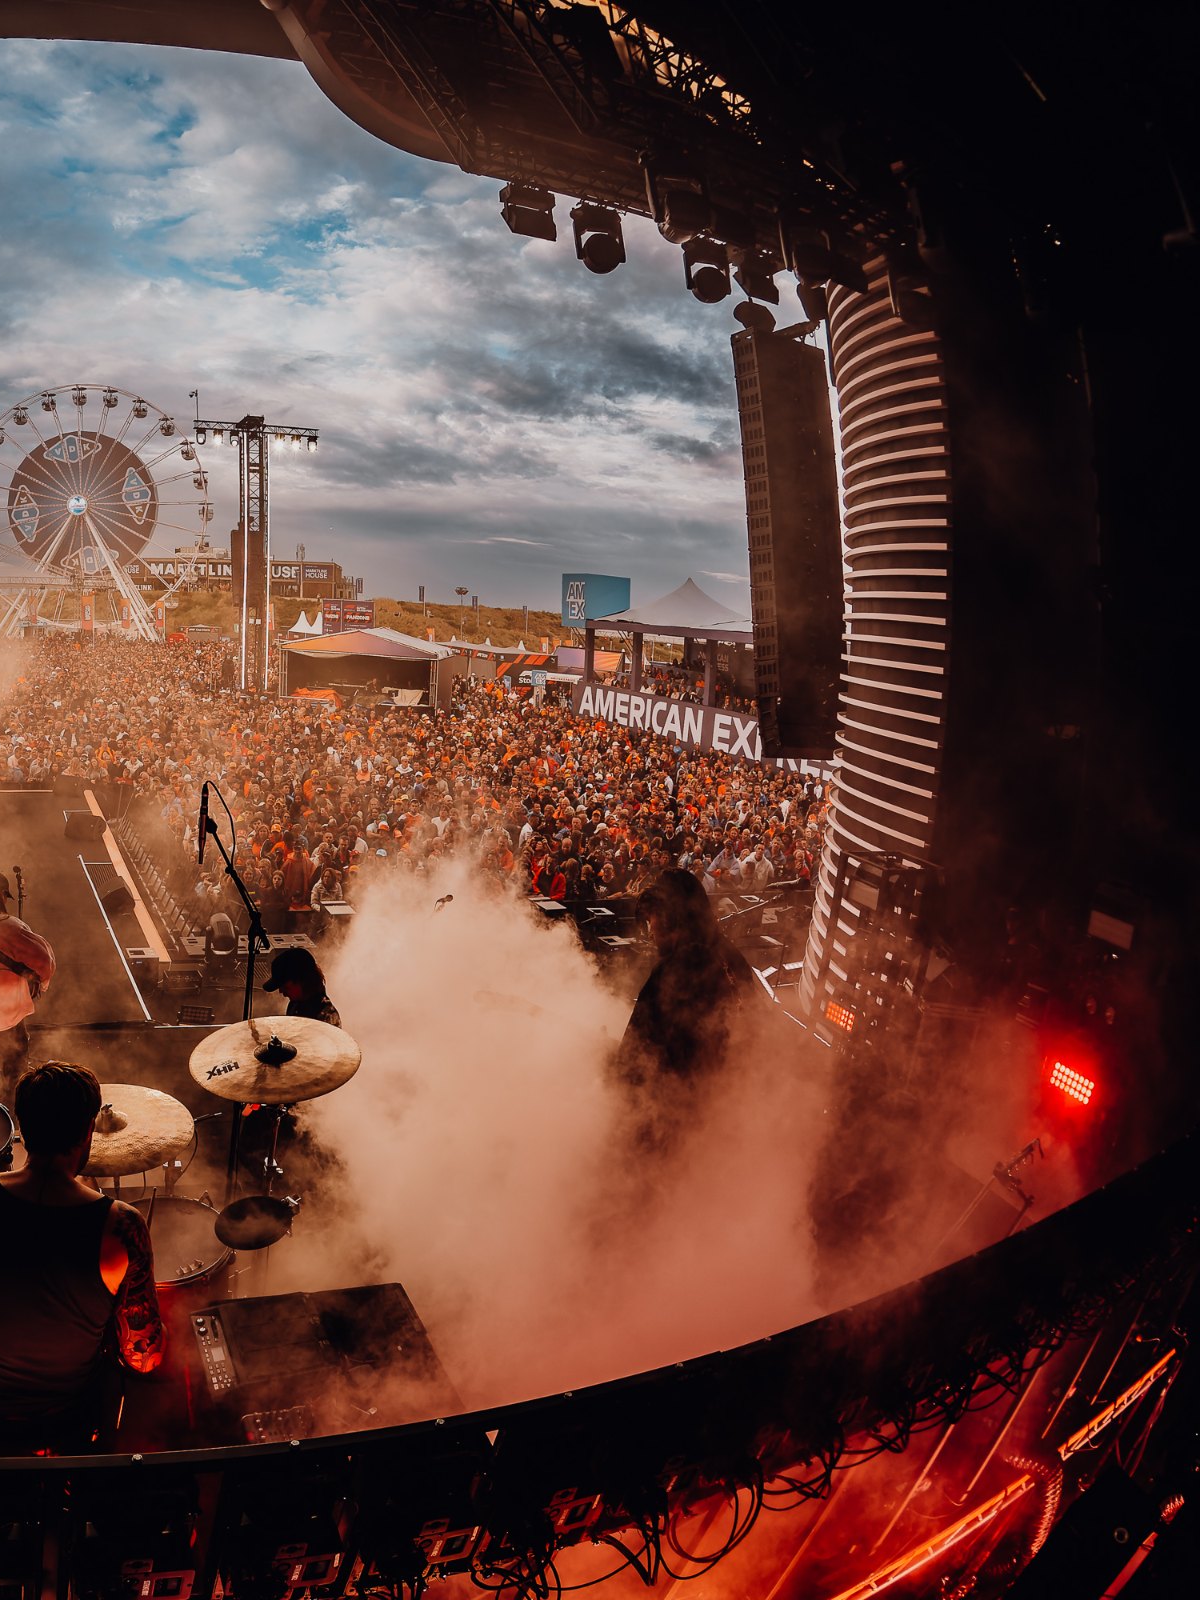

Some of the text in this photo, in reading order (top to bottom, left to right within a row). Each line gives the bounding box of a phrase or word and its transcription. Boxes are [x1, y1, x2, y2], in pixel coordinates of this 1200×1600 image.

[55, 443, 90, 455] VDK
[566, 581, 585, 601] AM
[568, 601, 585, 619] EX
[578, 685, 704, 745] AMERICAN
[206, 1061, 239, 1080] HHX
